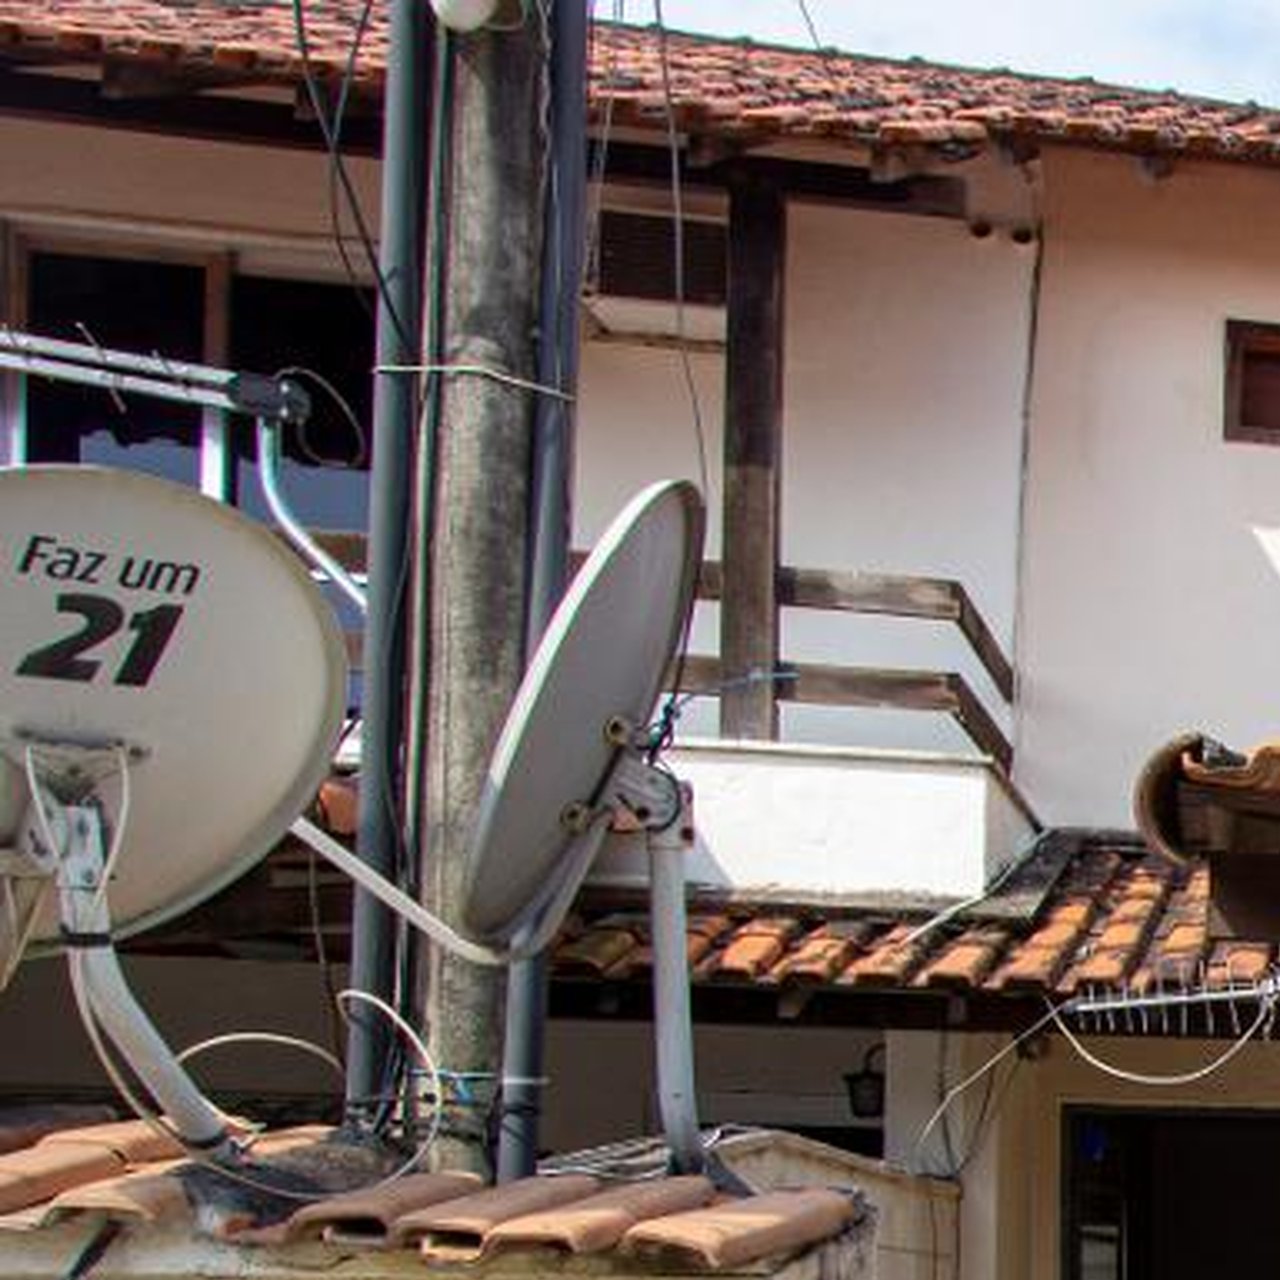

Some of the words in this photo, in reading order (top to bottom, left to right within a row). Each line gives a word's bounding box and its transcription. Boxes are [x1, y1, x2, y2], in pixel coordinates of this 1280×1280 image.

[18, 534, 107, 585] Faz
[119, 554, 200, 596] um
[16, 592, 184, 687] 21
